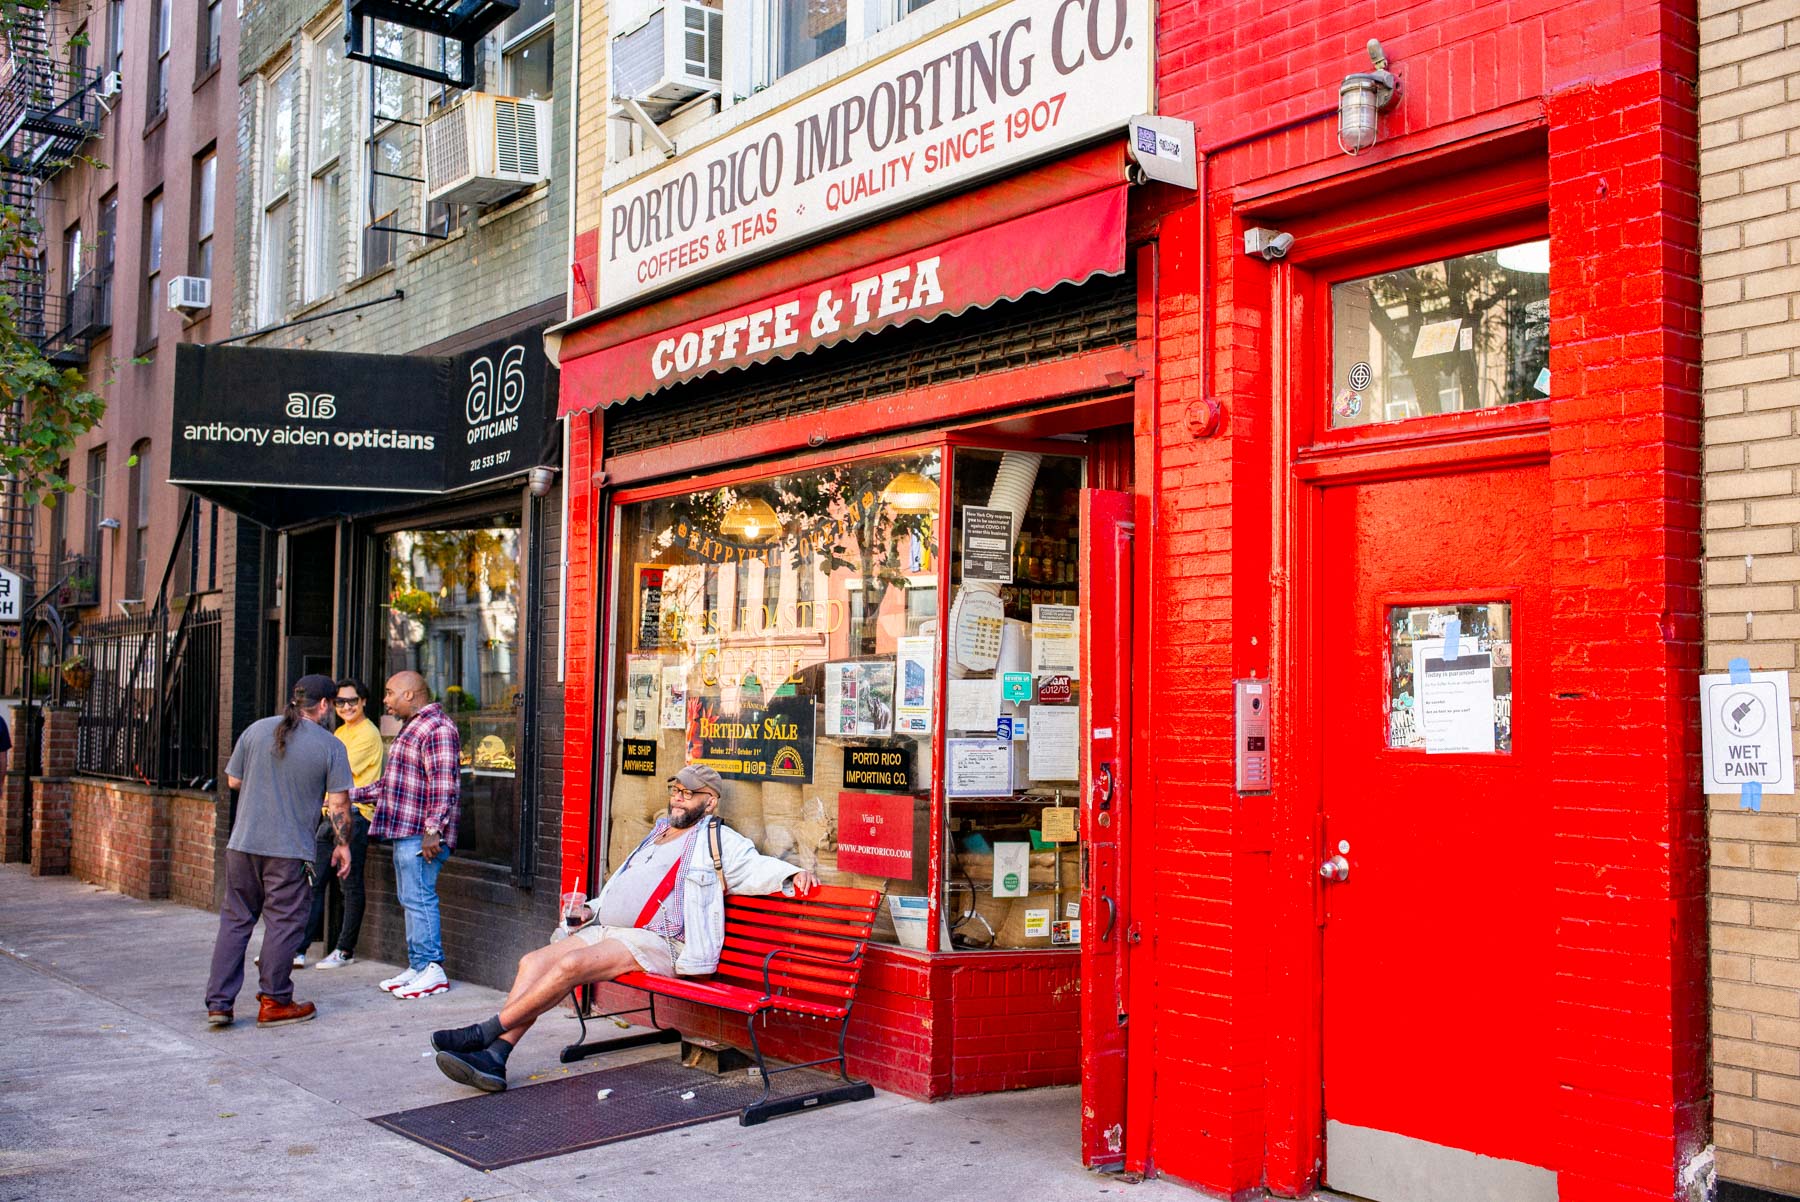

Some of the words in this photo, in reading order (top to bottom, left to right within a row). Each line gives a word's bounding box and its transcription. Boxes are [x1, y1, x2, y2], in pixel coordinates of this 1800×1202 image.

[609, 171, 699, 262] PORTO
[705, 130, 784, 223] RICO
[793, 16, 1036, 187] IMPORTING
[1051, 0, 1134, 76] CO.
[825, 152, 916, 212] QUALITY
[924, 120, 996, 174] SINCE
[1004, 92, 1067, 143] 1907
[637, 234, 709, 284] COFFEES
[715, 228, 727, 254] &
[731, 207, 778, 247] TEAS
[651, 299, 800, 380] COFFEE
[809, 289, 843, 338] &
[850, 255, 944, 327] TEA
[183, 421, 270, 447] anthony
[272, 425, 329, 446] aiden
[333, 429, 436, 451] opticians
[466, 415, 519, 445] OPTICIANS
[470, 458, 481, 472] 212
[481, 454, 495, 469] 533
[495, 450, 511, 465] 1577
[740, 599, 844, 639] ROASTED
[701, 645, 805, 687] COFFEE
[1040, 685, 1070, 695] 2012/13
[627, 744, 637, 756] WE
[637, 745, 652, 757] SHIP
[1728, 744, 1761, 760] WET
[623, 759, 655, 773] ANYWHERE
[852, 752, 880, 765] PORTO
[881, 753, 902, 766] RICO
[1724, 762, 1768, 777] PAINT
[846, 770, 892, 785] IMPORTING
[893, 772, 908, 786] CO.
[861, 813, 875, 824] Visit
[875, 815, 884, 825] Us
[869, 826, 877, 837] @
[838, 843, 912, 859] WWW.PORTORICO.COM
